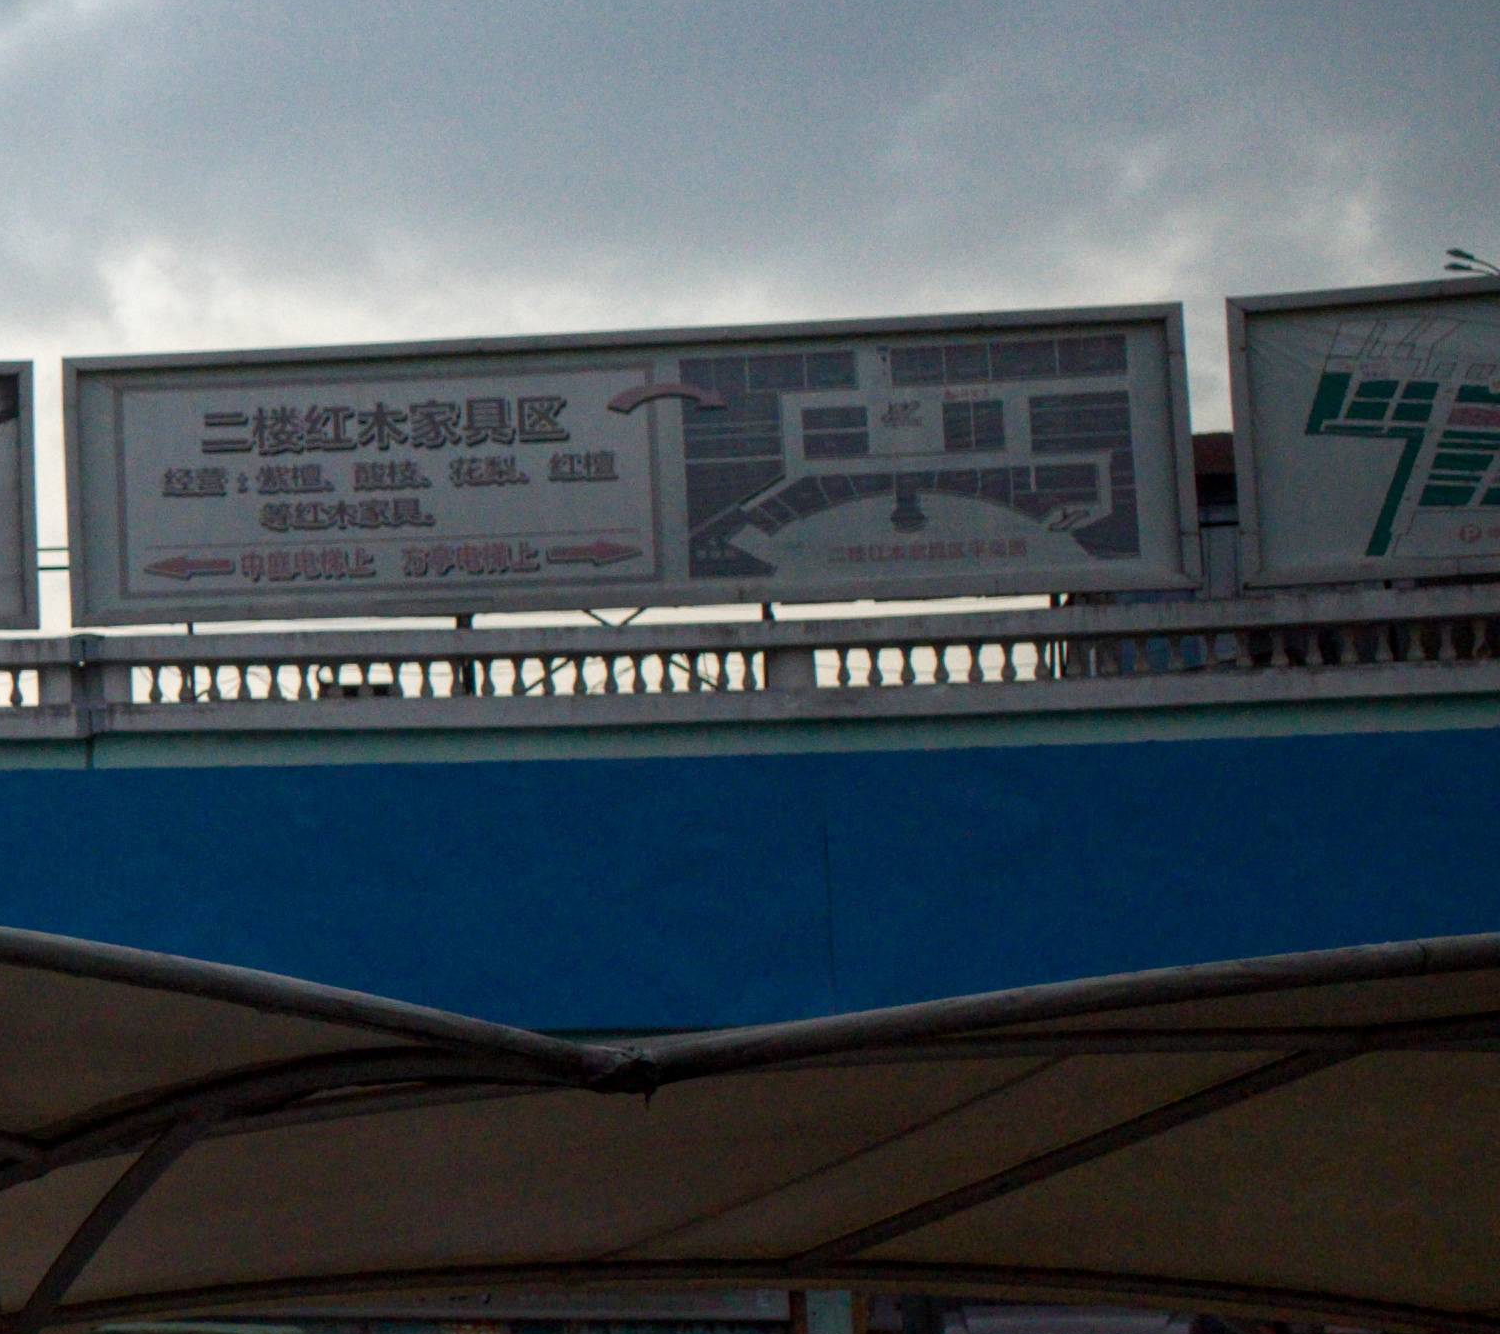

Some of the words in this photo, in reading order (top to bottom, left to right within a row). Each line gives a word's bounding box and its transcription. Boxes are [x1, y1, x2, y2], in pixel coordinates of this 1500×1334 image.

[200, 394, 570, 456] 二楼红木家具区
